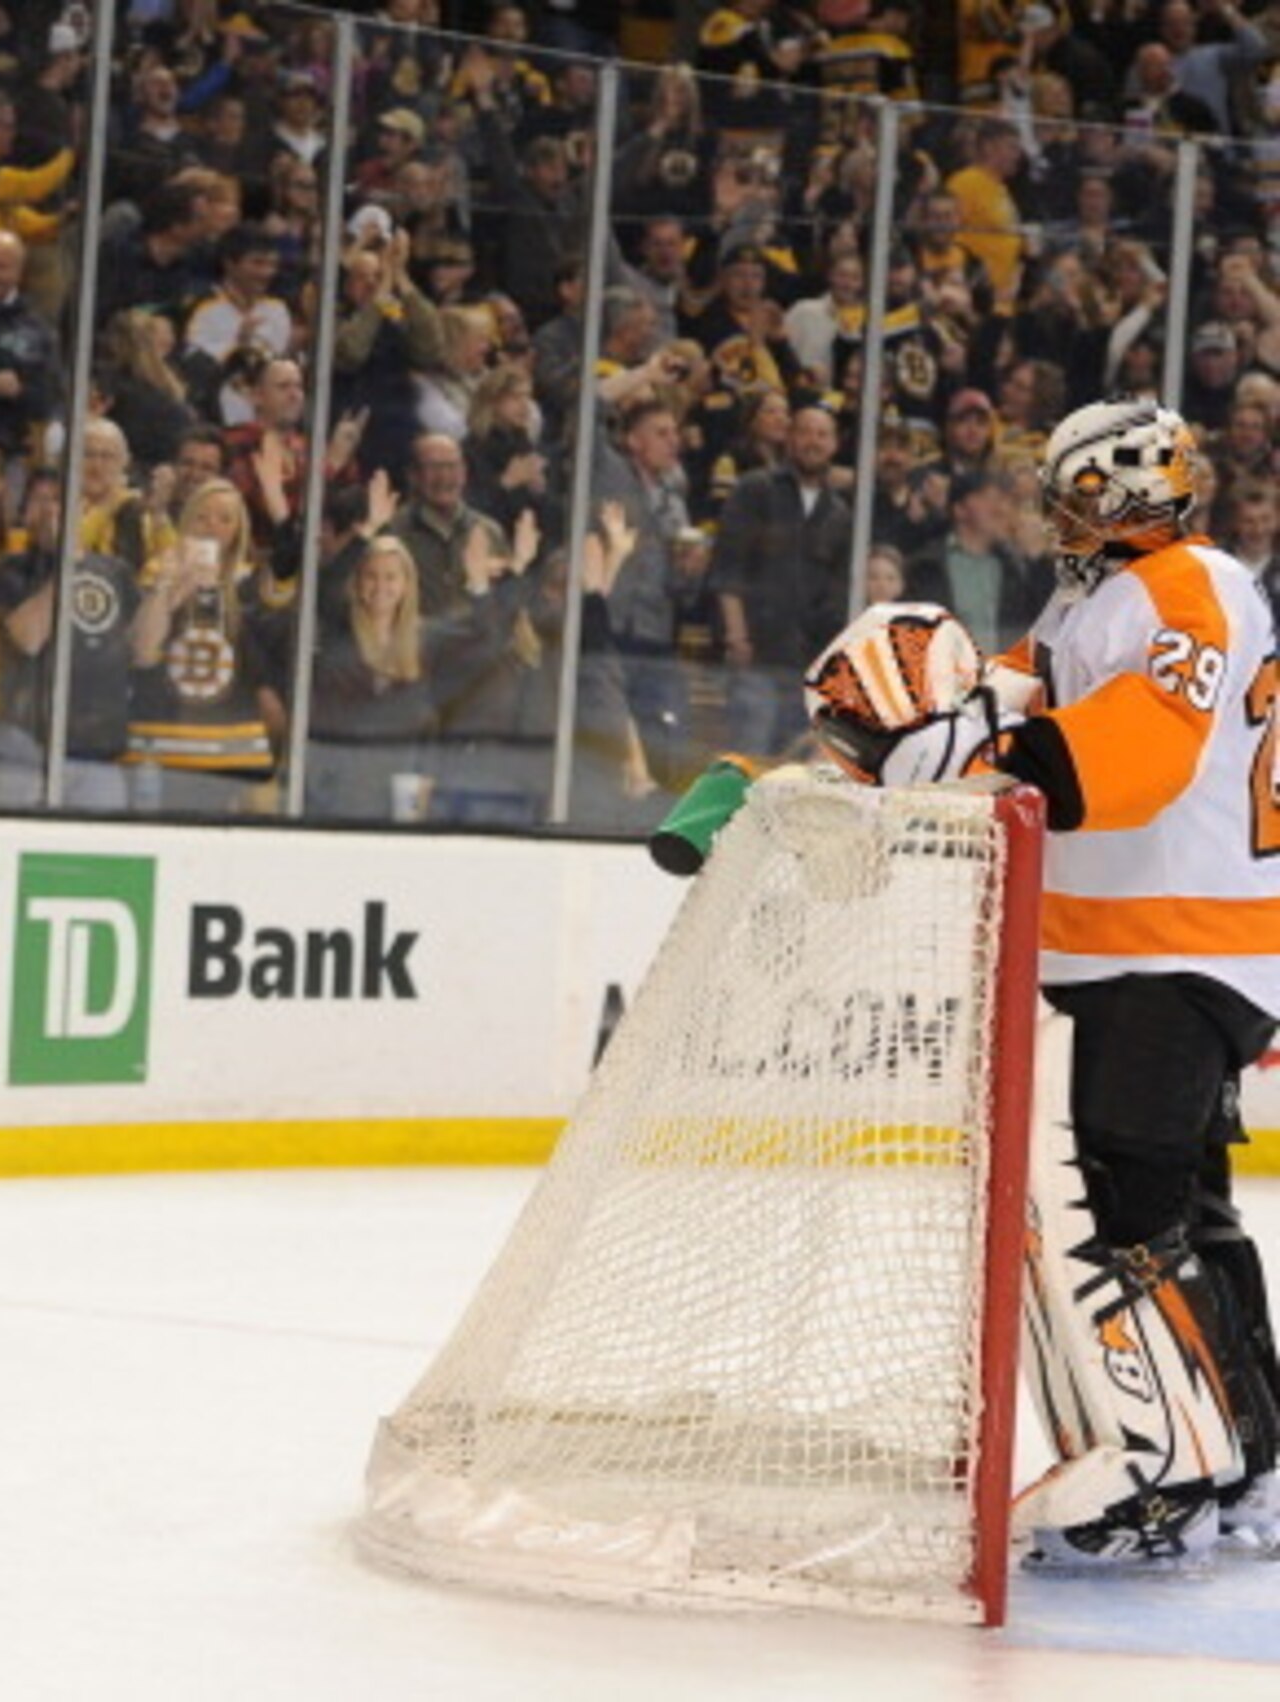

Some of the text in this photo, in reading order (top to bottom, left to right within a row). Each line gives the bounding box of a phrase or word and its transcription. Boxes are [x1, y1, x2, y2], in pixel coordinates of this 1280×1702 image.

[1148, 628, 1228, 711] 29
[27, 898, 421, 1039] TD Bank
